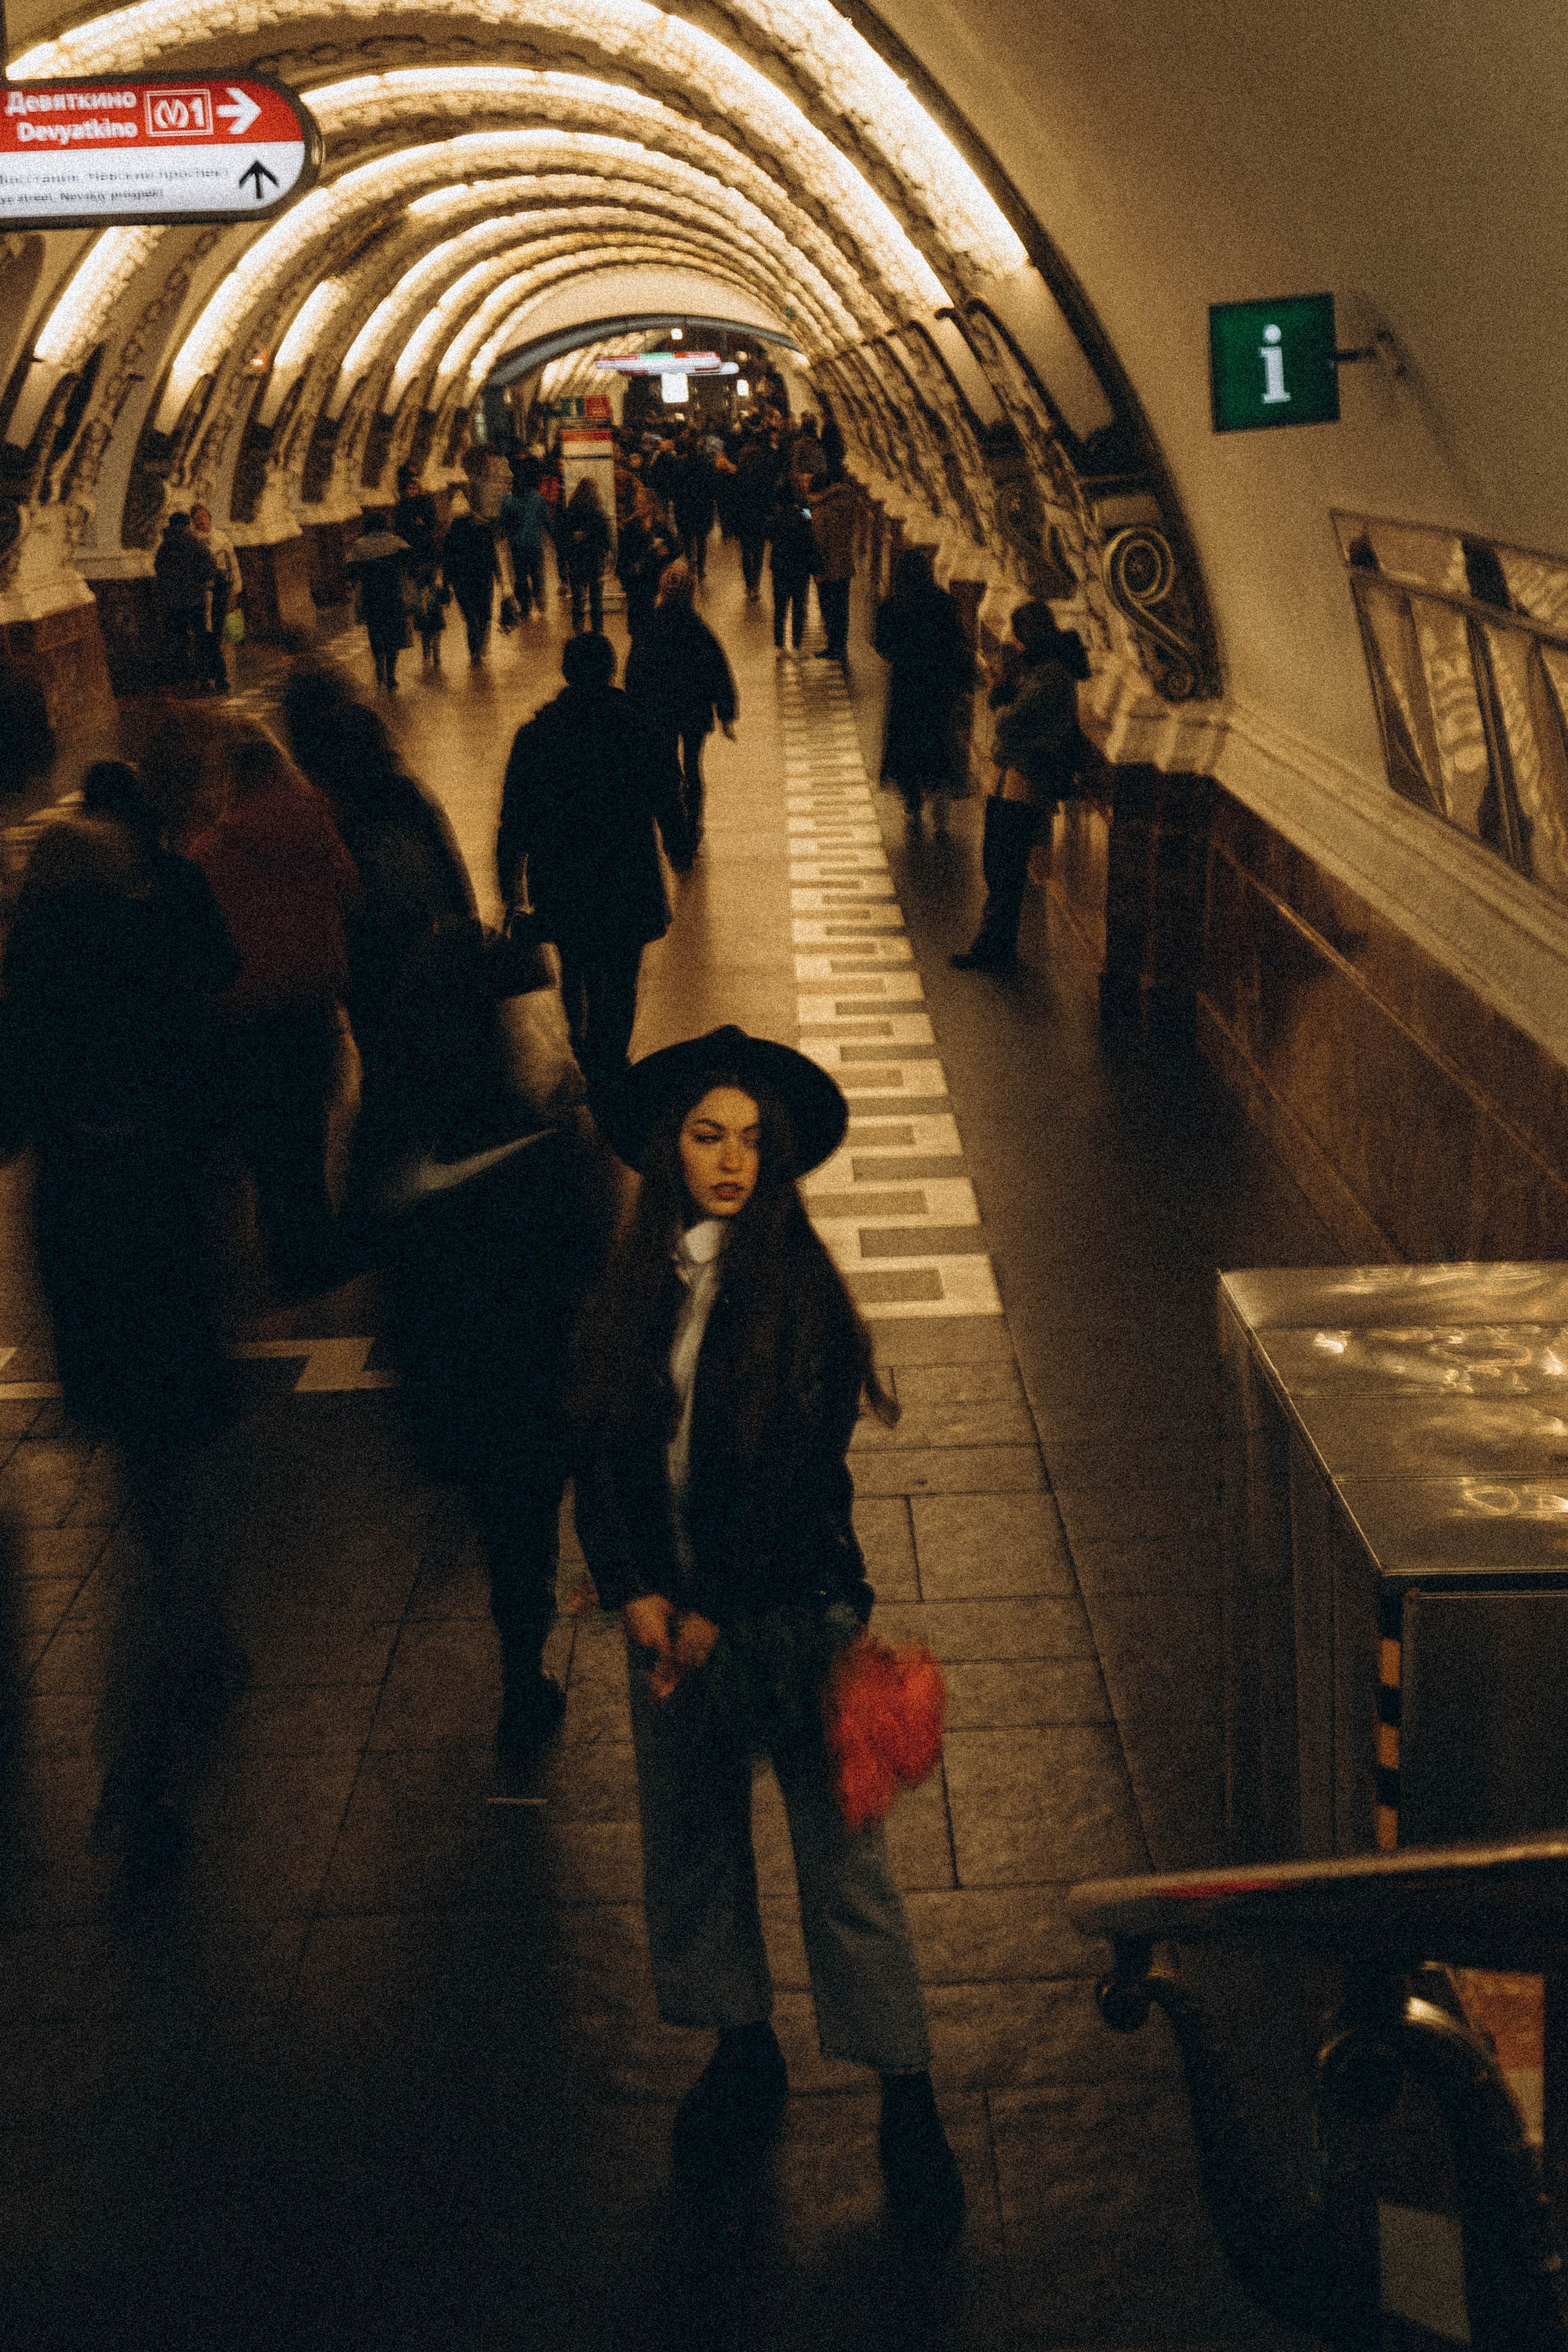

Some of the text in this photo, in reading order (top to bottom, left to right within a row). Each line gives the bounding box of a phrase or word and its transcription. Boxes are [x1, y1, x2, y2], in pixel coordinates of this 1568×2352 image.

[6, 91, 137, 116] Девяткино
[17, 119, 138, 145] Devyatkino
[1259, 323, 1291, 403] i
